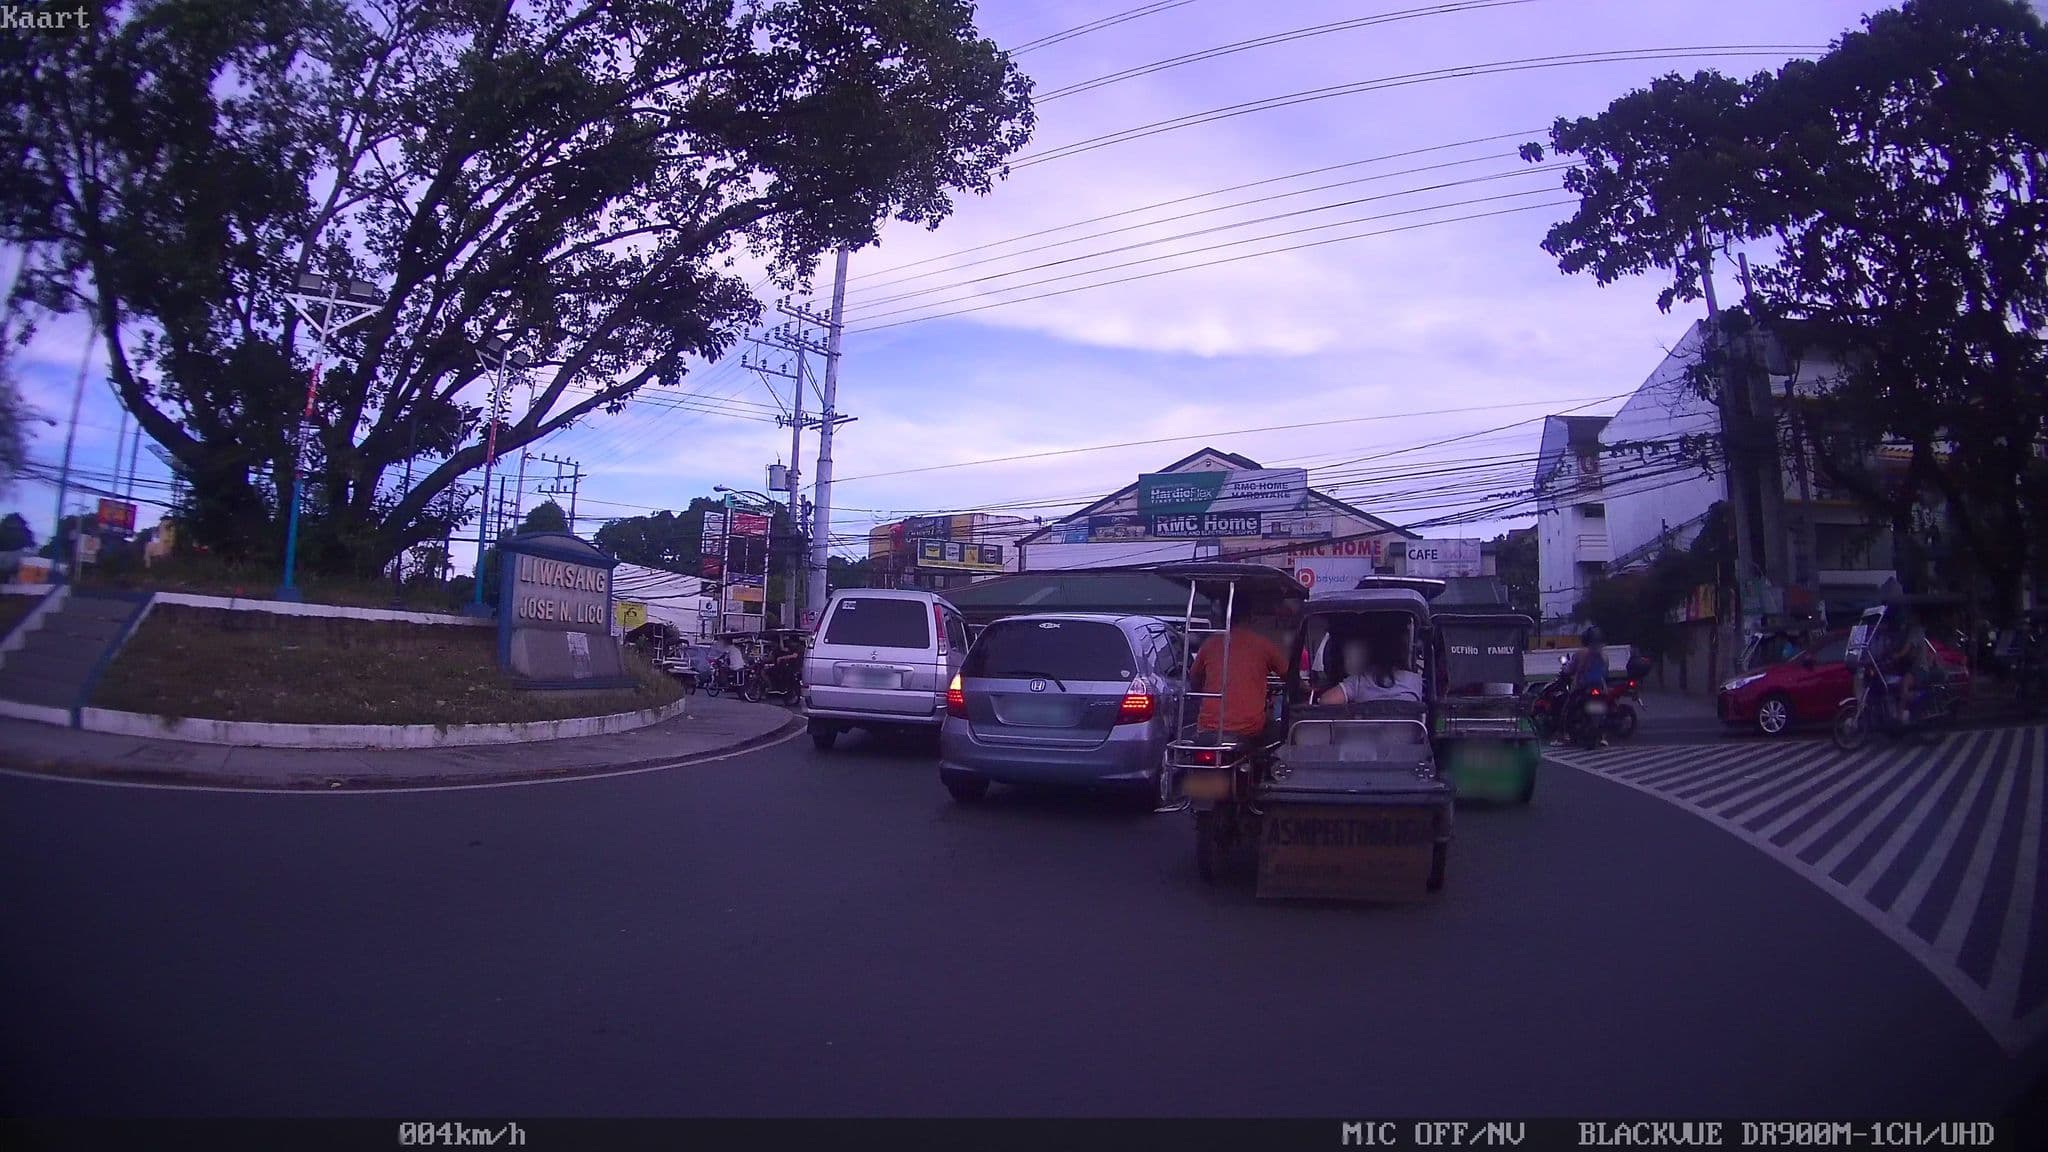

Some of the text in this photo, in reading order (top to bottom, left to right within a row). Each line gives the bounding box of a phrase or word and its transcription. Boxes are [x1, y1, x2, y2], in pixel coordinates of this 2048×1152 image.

[1233, 481, 1289, 490] RMC HOME
[1157, 515, 1198, 532] RMC
[1204, 514, 1258, 531] Home
[1333, 541, 1381, 555] HOME
[1407, 549, 1438, 560] CAFE
[521, 556, 605, 593] LIWASANG
[519, 597, 605, 624] JOSE N. LICO
[1487, 646, 1515, 655] FAMILY
